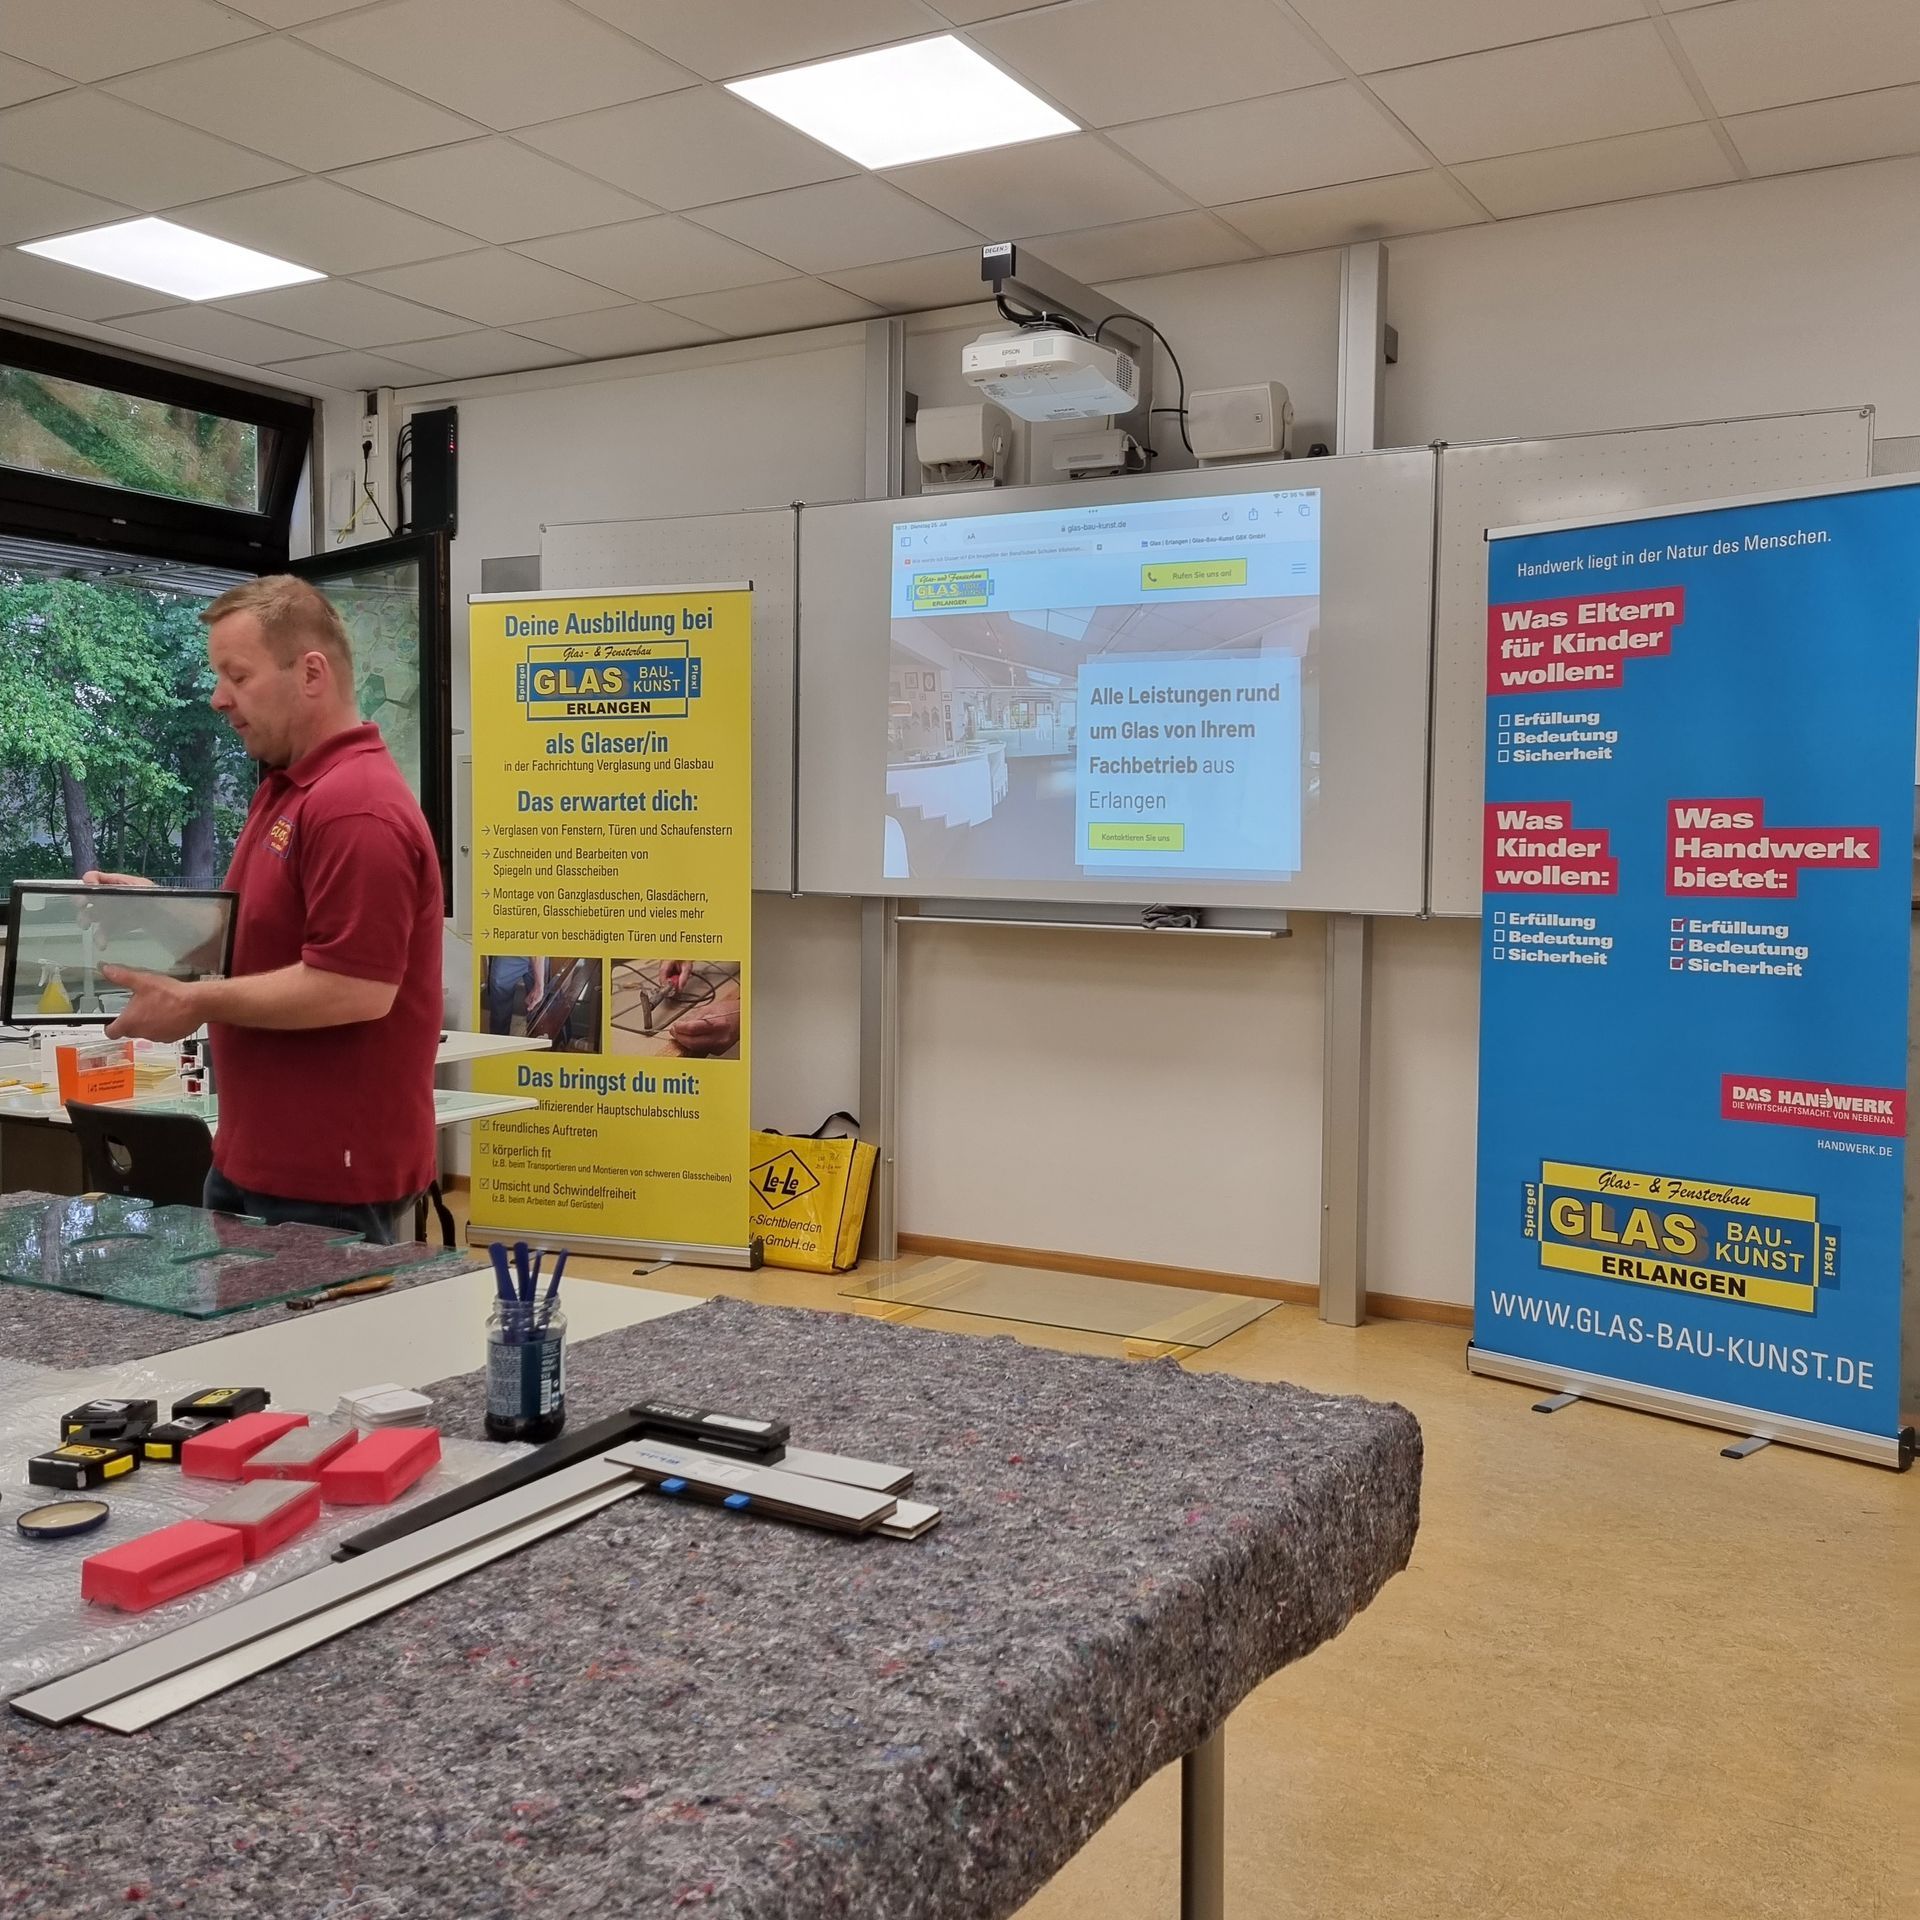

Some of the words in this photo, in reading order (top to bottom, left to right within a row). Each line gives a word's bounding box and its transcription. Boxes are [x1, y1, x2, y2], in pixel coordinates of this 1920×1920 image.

[1068, 520, 1127, 533] glas-bau-kunst.de
[1517, 555, 1584, 577] Handwerk
[1588, 554, 1618, 570] liegt
[1622, 551, 1634, 565] in
[1639, 549, 1662, 564] der
[1667, 543, 1708, 561] Natur
[1713, 540, 1740, 555] des
[1744, 528, 1832, 551] Menschen.
[917, 584, 959, 597] GLAS
[506, 615, 559, 636] Deine
[565, 610, 675, 636] Ausbildung
[682, 607, 713, 629] bei
[1501, 609, 1568, 631] Was
[1578, 599, 1675, 626] Eltern
[563, 648, 589, 660] Glas-
[594, 646, 601, 657] &
[605, 646, 651, 659] Fensterbau
[1501, 638, 1544, 659] für
[1553, 630, 1663, 655] Kinder
[533, 666, 624, 695] GLAS
[639, 665, 674, 679] BAU-
[1500, 663, 1614, 686] wollen:
[633, 678, 681, 693] KUNST
[1091, 687, 1124, 705] Alle
[1129, 686, 1231, 706] Leistungen
[1236, 683, 1280, 702] rund
[567, 701, 651, 715] ERLANGEN
[1514, 711, 1600, 727] Erfüllung
[1090, 726, 1117, 739] um
[1122, 721, 1159, 738] Glas
[1164, 725, 1196, 738] von
[1201, 720, 1255, 738] Ihrem
[1514, 729, 1618, 745] Bedeutung
[546, 732, 575, 754] als
[581, 730, 668, 756] Glaser/in
[1513, 747, 1612, 762] Sicherheit
[504, 760, 512, 772] in
[514, 759, 530, 771] der
[532, 759, 594, 773] Fachrichtung
[597, 759, 650, 772] Verglasung
[654, 758, 671, 770] und
[674, 758, 714, 770] Glasbau
[1090, 756, 1198, 774] Fachbetrieb
[1202, 760, 1235, 774] aus
[518, 790, 554, 812] Das
[560, 791, 646, 812] erwartet
[652, 789, 698, 812] dich:
[1090, 791, 1166, 813] Erlangen
[1496, 810, 1563, 830] Was
[1674, 807, 1754, 829] Was
[493, 824, 538, 837] Verglasen
[541, 827, 558, 836] von
[561, 825, 606, 837] Fenstern,
[608, 824, 636, 836] Türen
[640, 824, 658, 836] und
[661, 824, 733, 836] Schaufenstern
[1101, 833, 1144, 842] Kontaktieren
[493, 848, 552, 860] Zuschneiden
[555, 848, 573, 860] und
[576, 848, 628, 860] Bearbeiten
[631, 851, 648, 860] von
[1496, 837, 1602, 858] Kinder
[1674, 837, 1871, 859] Handwerk
[493, 865, 532, 878] Spiegeln
[535, 865, 553, 876] und
[556, 865, 619, 877] Glasscheiben
[1496, 865, 1610, 886] wollen:
[1674, 866, 1788, 890] bietet:
[493, 888, 534, 902] Montage
[537, 891, 555, 900] von
[557, 889, 643, 902] Ganzglasduschen,
[646, 890, 709, 903] Glasdächern,
[493, 906, 540, 918] Glastüren,
[543, 906, 625, 918] Glasschiebetüren
[628, 907, 647, 918] und
[650, 907, 677, 918] vieles
[680, 908, 704, 919] mehr
[1509, 912, 1596, 930] Erfüllung
[493, 928, 539, 942] Reparatur
[542, 931, 559, 940] von
[562, 930, 625, 944] beschädigten
[628, 930, 657, 942] Türen
[660, 931, 677, 943] und
[680, 932, 723, 944] Fenstern
[1689, 919, 1789, 938] Erfüllung
[1508, 931, 1613, 949] Bedeutung
[1689, 939, 1809, 959] Bedeutung
[1508, 949, 1608, 966] Sicherheit
[1688, 958, 1803, 977] Sicherheit
[518, 1065, 554, 1088] Das
[560, 1067, 626, 1096] bringst
[632, 1070, 656, 1093] du
[663, 1072, 700, 1095] mit:
[1732, 1086, 1776, 1102] DAS
[1778, 1088, 1893, 1115] HANDWERK
[597, 1103, 700, 1120] Hauptschulabschluss
[1732, 1101, 1745, 1109] DIE
[1746, 1102, 1831, 1118] WIRTSCHAFTSMACHT.
[1833, 1112, 1850, 1120] VON
[1852, 1114, 1895, 1124] NEBENAN.
[492, 1120, 550, 1136] freundliches
[552, 1124, 598, 1138] Auftreten
[492, 1144, 539, 1160] körperlich
[542, 1147, 551, 1158] fit
[1817, 1139, 1893, 1157] HANDWERK.DE
[492, 1159, 506, 1168] (z.B.
[508, 1160, 525, 1170] beim
[527, 1161, 576, 1174] Transportieren
[578, 1164, 591, 1174] und
[593, 1165, 628, 1176] Montieren
[645, 1169, 680, 1179] schweren
[682, 1171, 732, 1183] Glasscheiben)
[762, 1166, 799, 1195] Le-Le
[492, 1178, 530, 1192] Umsicht
[533, 1182, 550, 1194] und
[553, 1183, 636, 1200] Schwindelfreiheit
[1598, 1171, 1639, 1191] Glas-
[1649, 1178, 1660, 1193] &
[1667, 1182, 1751, 1206] Fensterbau
[492, 1194, 506, 1203] (z.B.
[508, 1194, 525, 1204] beim
[527, 1196, 555, 1206] Arbeiten
[557, 1197, 569, 1207] auf
[570, 1198, 604, 1210] Gerüsten)
[1524, 1184, 1537, 1237] Spiegel
[1550, 1196, 1697, 1255] GLAS
[1727, 1222, 1792, 1247] BAU-
[1715, 1242, 1804, 1273] KUNST
[1824, 1236, 1836, 1276] Plexi
[1602, 1255, 1746, 1297] ERLANGEN
[1491, 1290, 1874, 1390] WWW.GLAS-BAU-KUNST.DE
